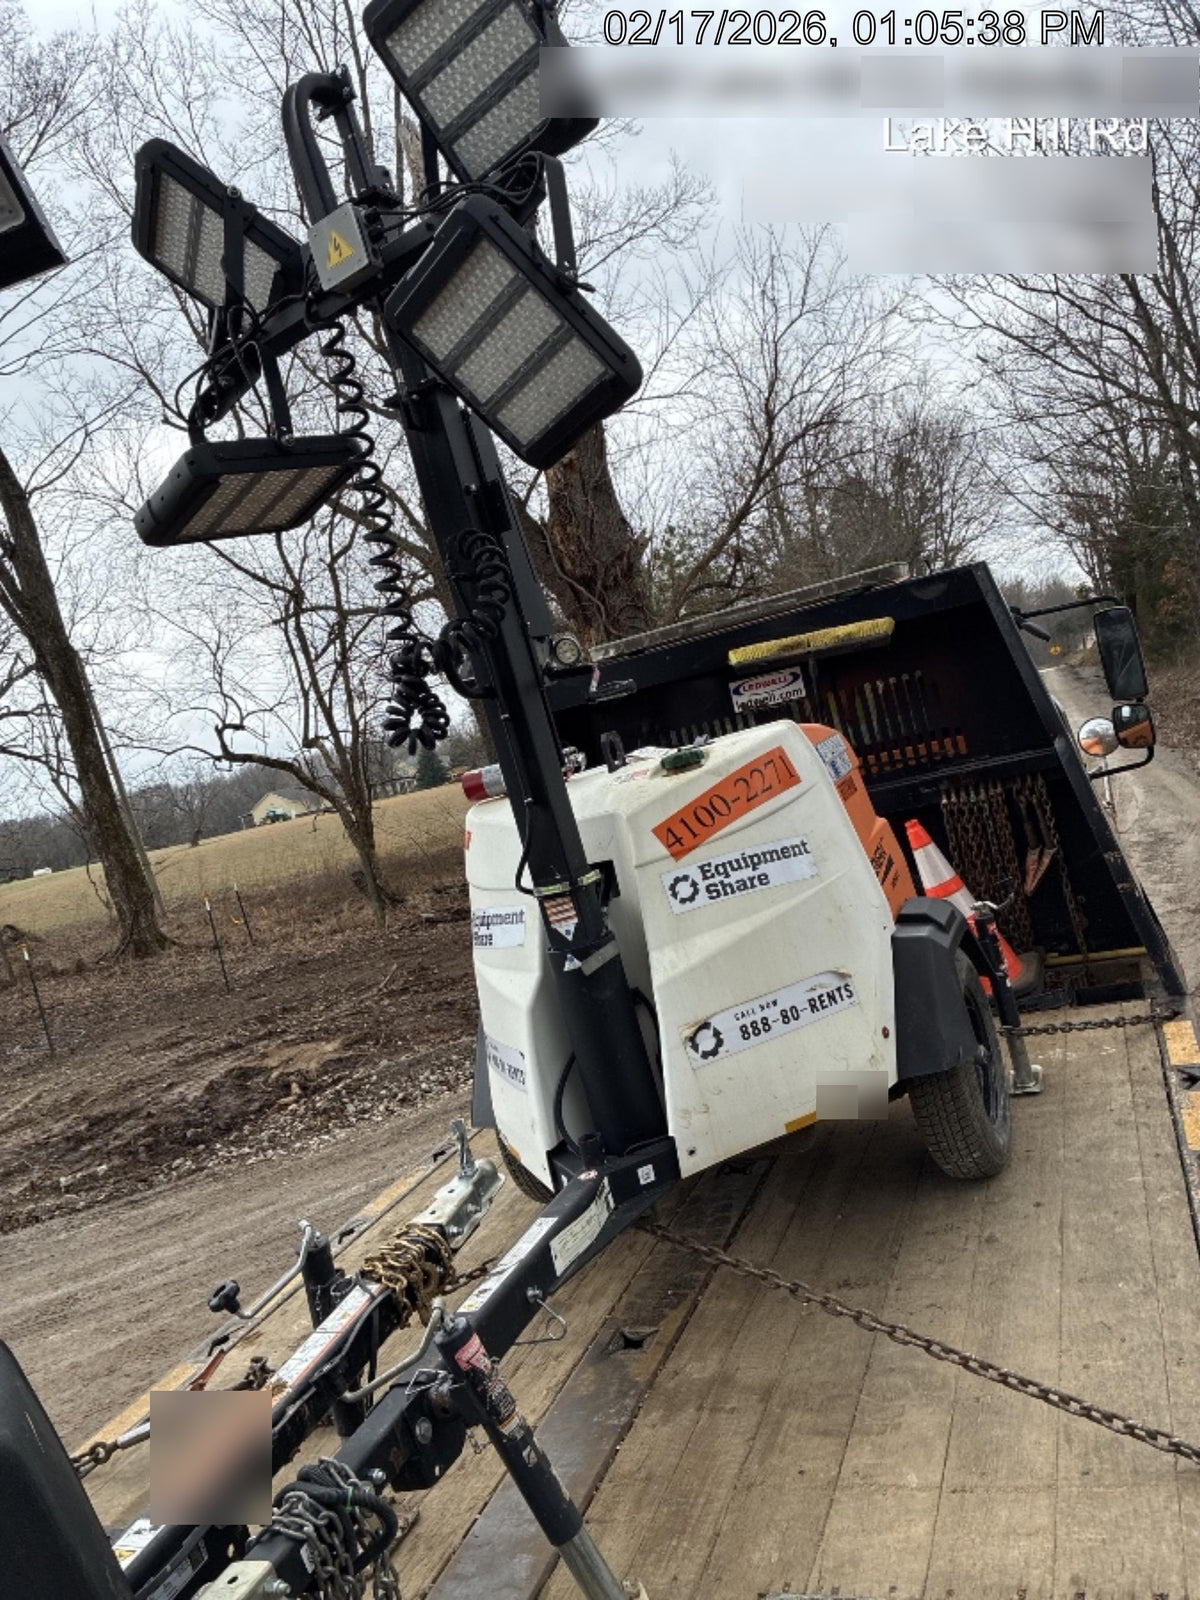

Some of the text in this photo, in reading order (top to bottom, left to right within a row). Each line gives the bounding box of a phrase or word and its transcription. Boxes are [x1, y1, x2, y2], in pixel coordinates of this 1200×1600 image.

[742, 675, 789, 692] LEDWELL
[666, 755, 795, 849] 4100-2271
[697, 839, 811, 881] Equipment
[705, 872, 771, 900] Share
[473, 909, 525, 930] quipment
[734, 1009, 756, 1021] CALL
[739, 983, 854, 1041] 888-80-RENTS
